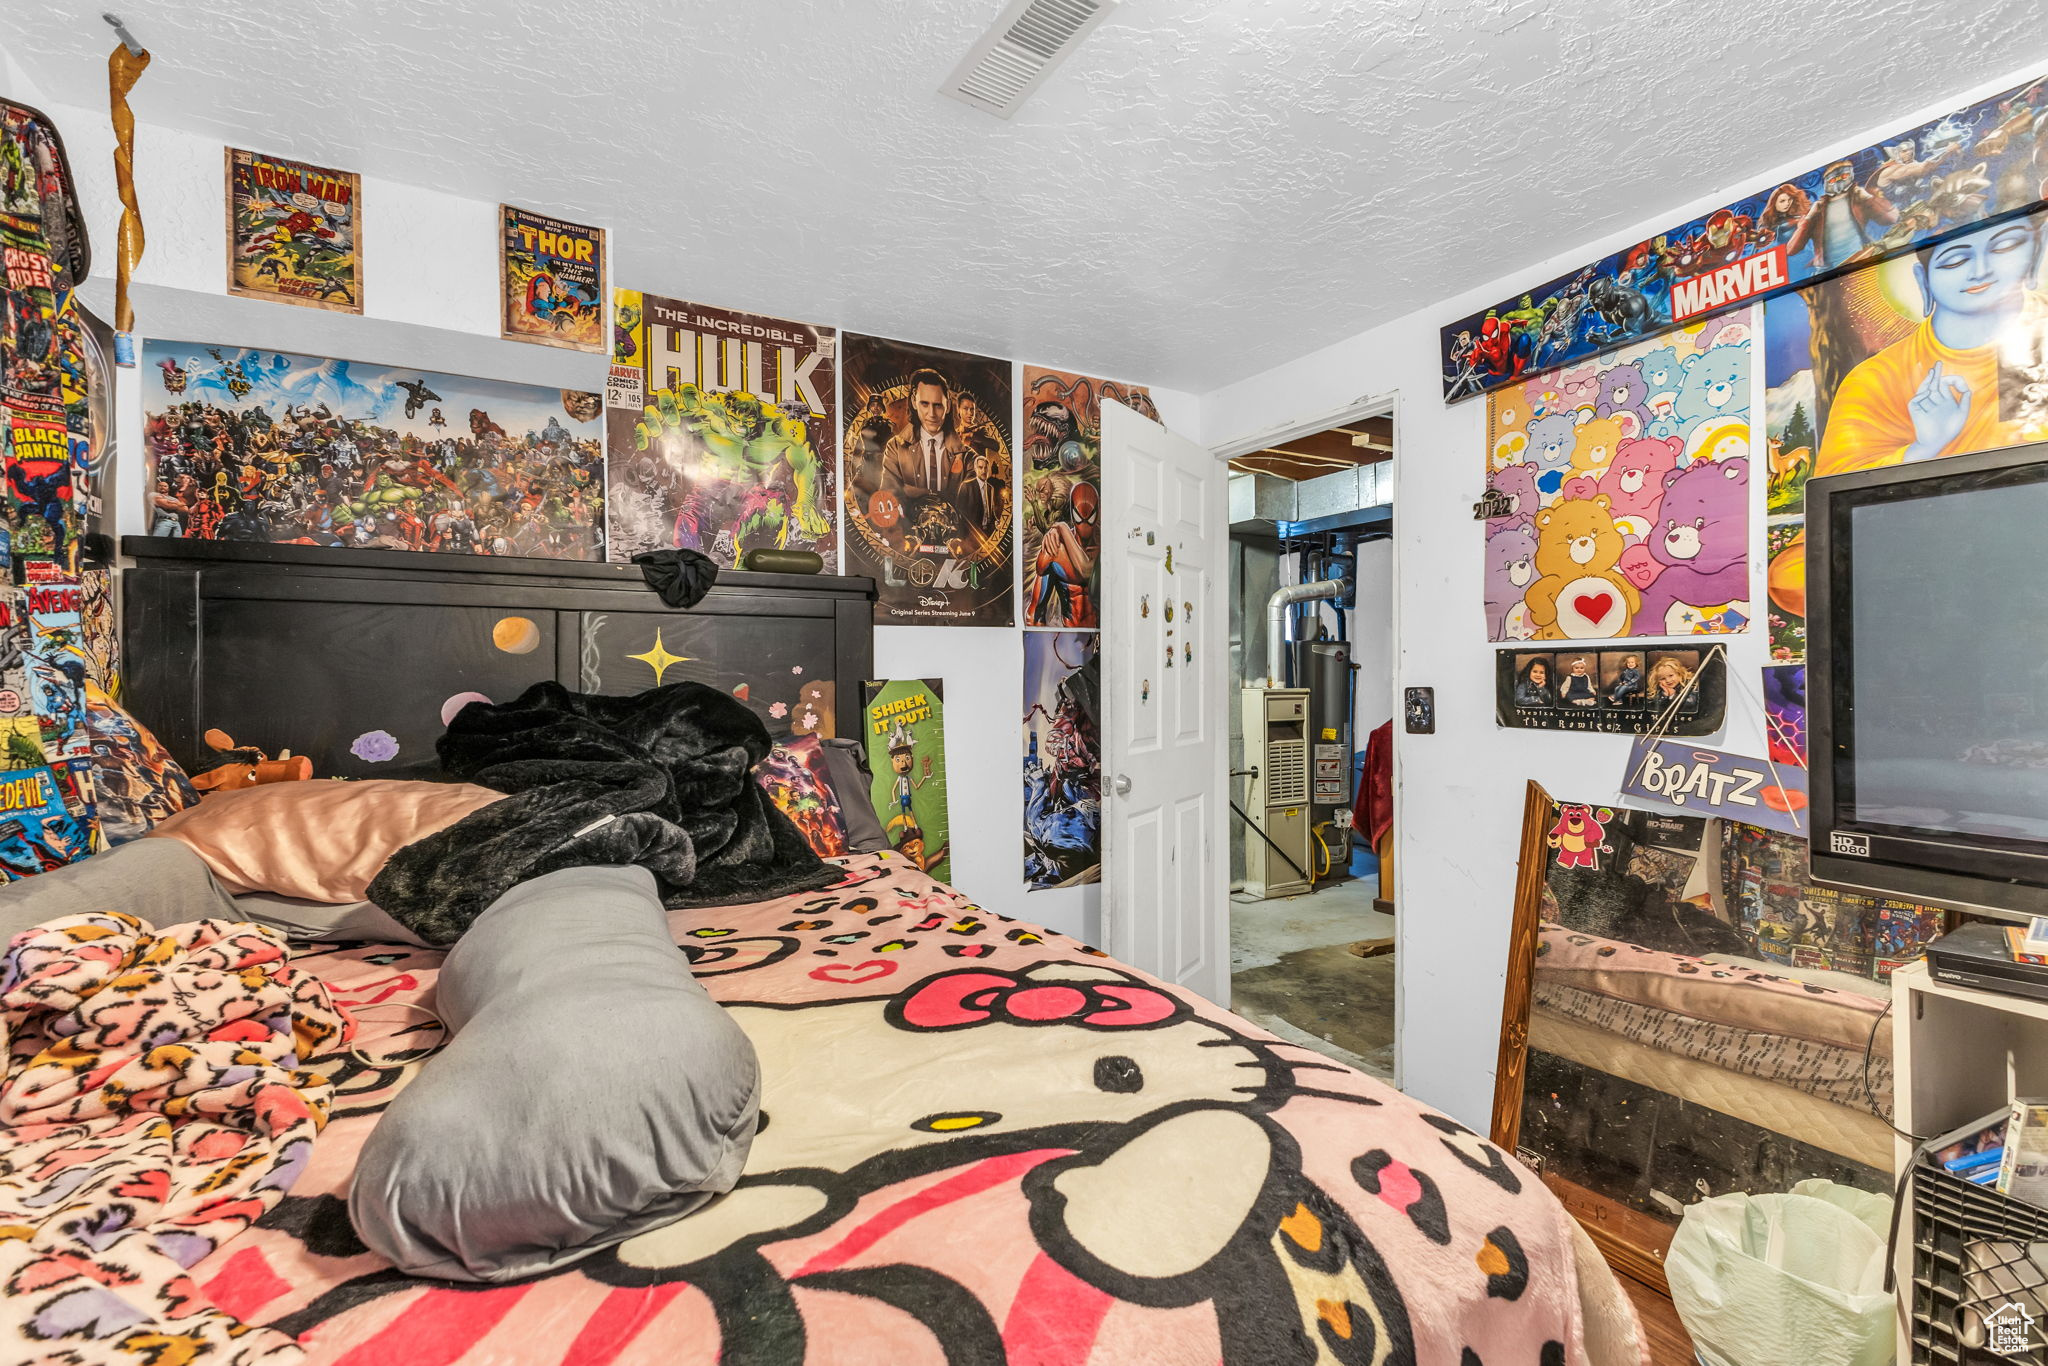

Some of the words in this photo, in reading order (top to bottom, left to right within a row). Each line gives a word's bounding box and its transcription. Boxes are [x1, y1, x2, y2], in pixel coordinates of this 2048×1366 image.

[253, 162, 301, 193] IRON
[307, 173, 351, 205] MAN
[518, 212, 545, 225] JOURNEY
[547, 220, 561, 229] INTO
[562, 223, 589, 234] MYSTERY
[518, 224, 594, 265] THOR
[4, 247, 49, 272] GHOST
[574, 264, 594, 272] HAND
[7, 268, 51, 290] RIDER
[558, 272, 594, 284] HAMMER!
[563, 267, 583, 276] THIS
[1673, 249, 1785, 319] MARVEL
[654, 306, 688, 323] THE
[696, 315, 804, 344] INCREDIBLE
[608, 376, 639, 385] COMICS
[648, 323, 827, 419] HULK
[628, 394, 641, 403] 105
[1473, 497, 1514, 520] 2022
[918, 591, 951, 609] Disney+
[891, 609, 914, 617] Original
[871, 693, 927, 719] SHREK
[873, 719, 889, 735] IT
[895, 706, 932, 727] OUT!
[1523, 717, 1547, 727] The
[1641, 750, 1764, 806] BRATZ
[1832, 844, 1867, 855] 1080
[1833, 836, 1854, 846] HD
